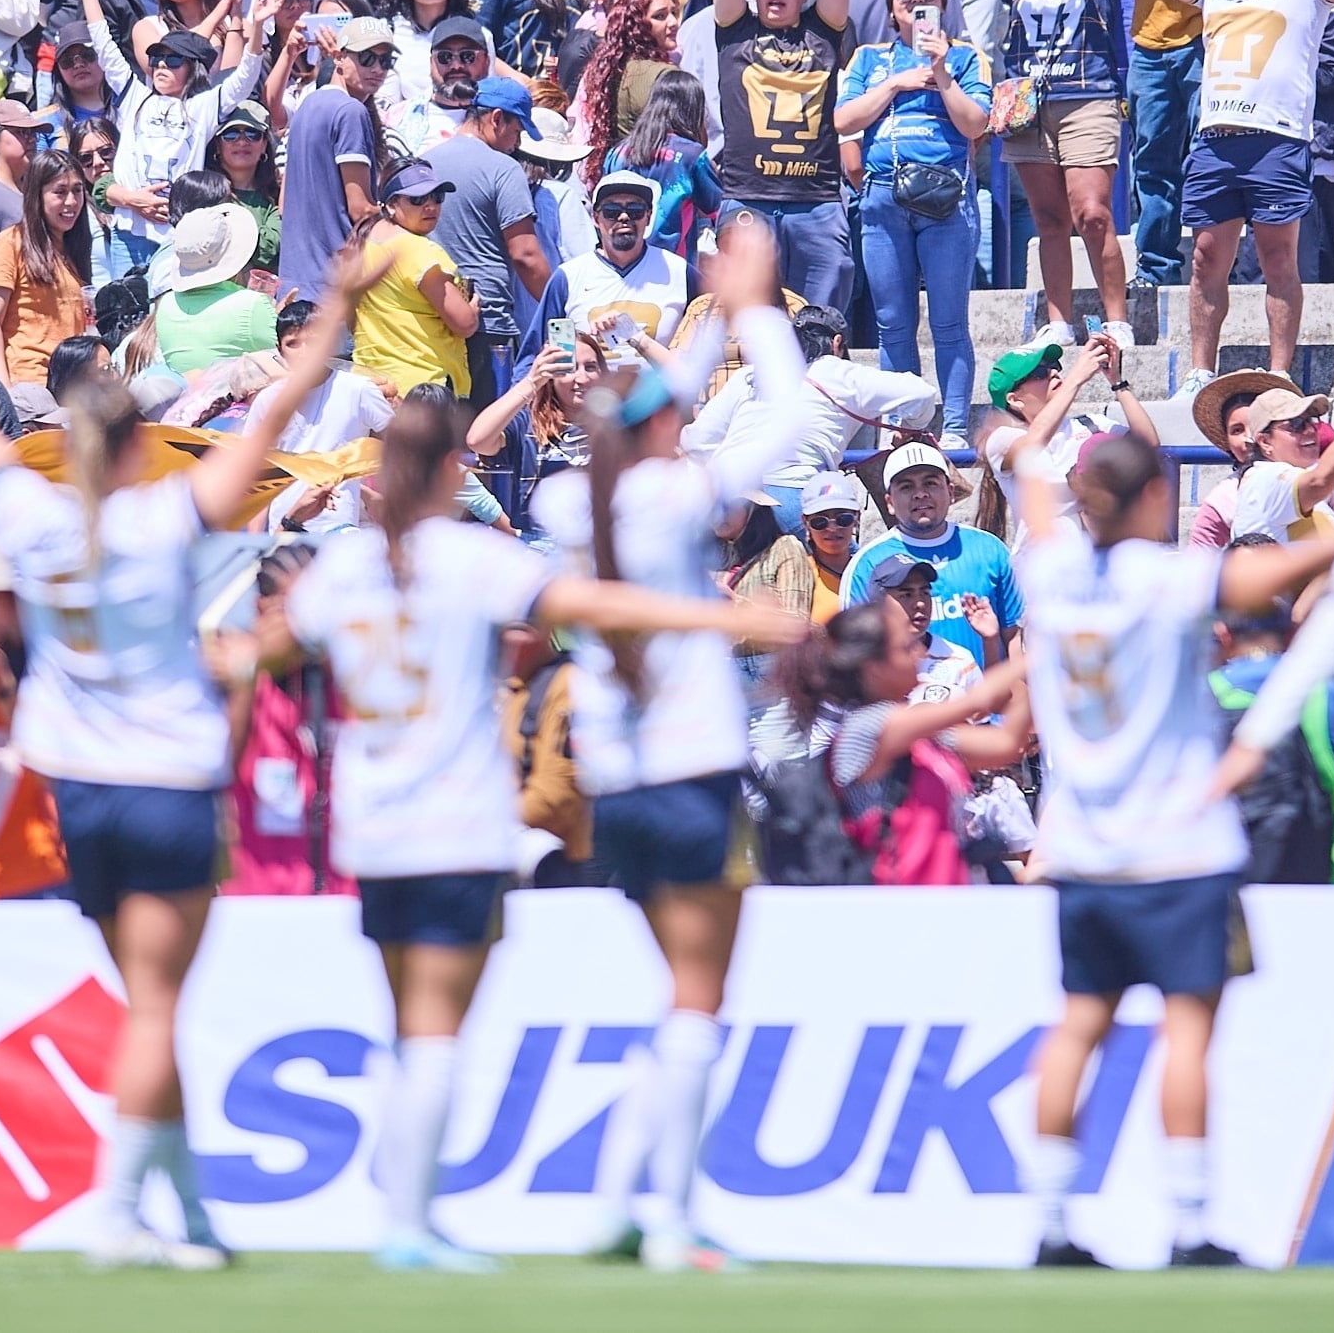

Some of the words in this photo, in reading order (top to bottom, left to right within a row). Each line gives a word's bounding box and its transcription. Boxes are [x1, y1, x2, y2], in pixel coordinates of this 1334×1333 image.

[1220, 99, 1258, 114] Mifel
[784, 161, 819, 178] Mifel
[191, 1022, 1159, 1204] SUZUKI
